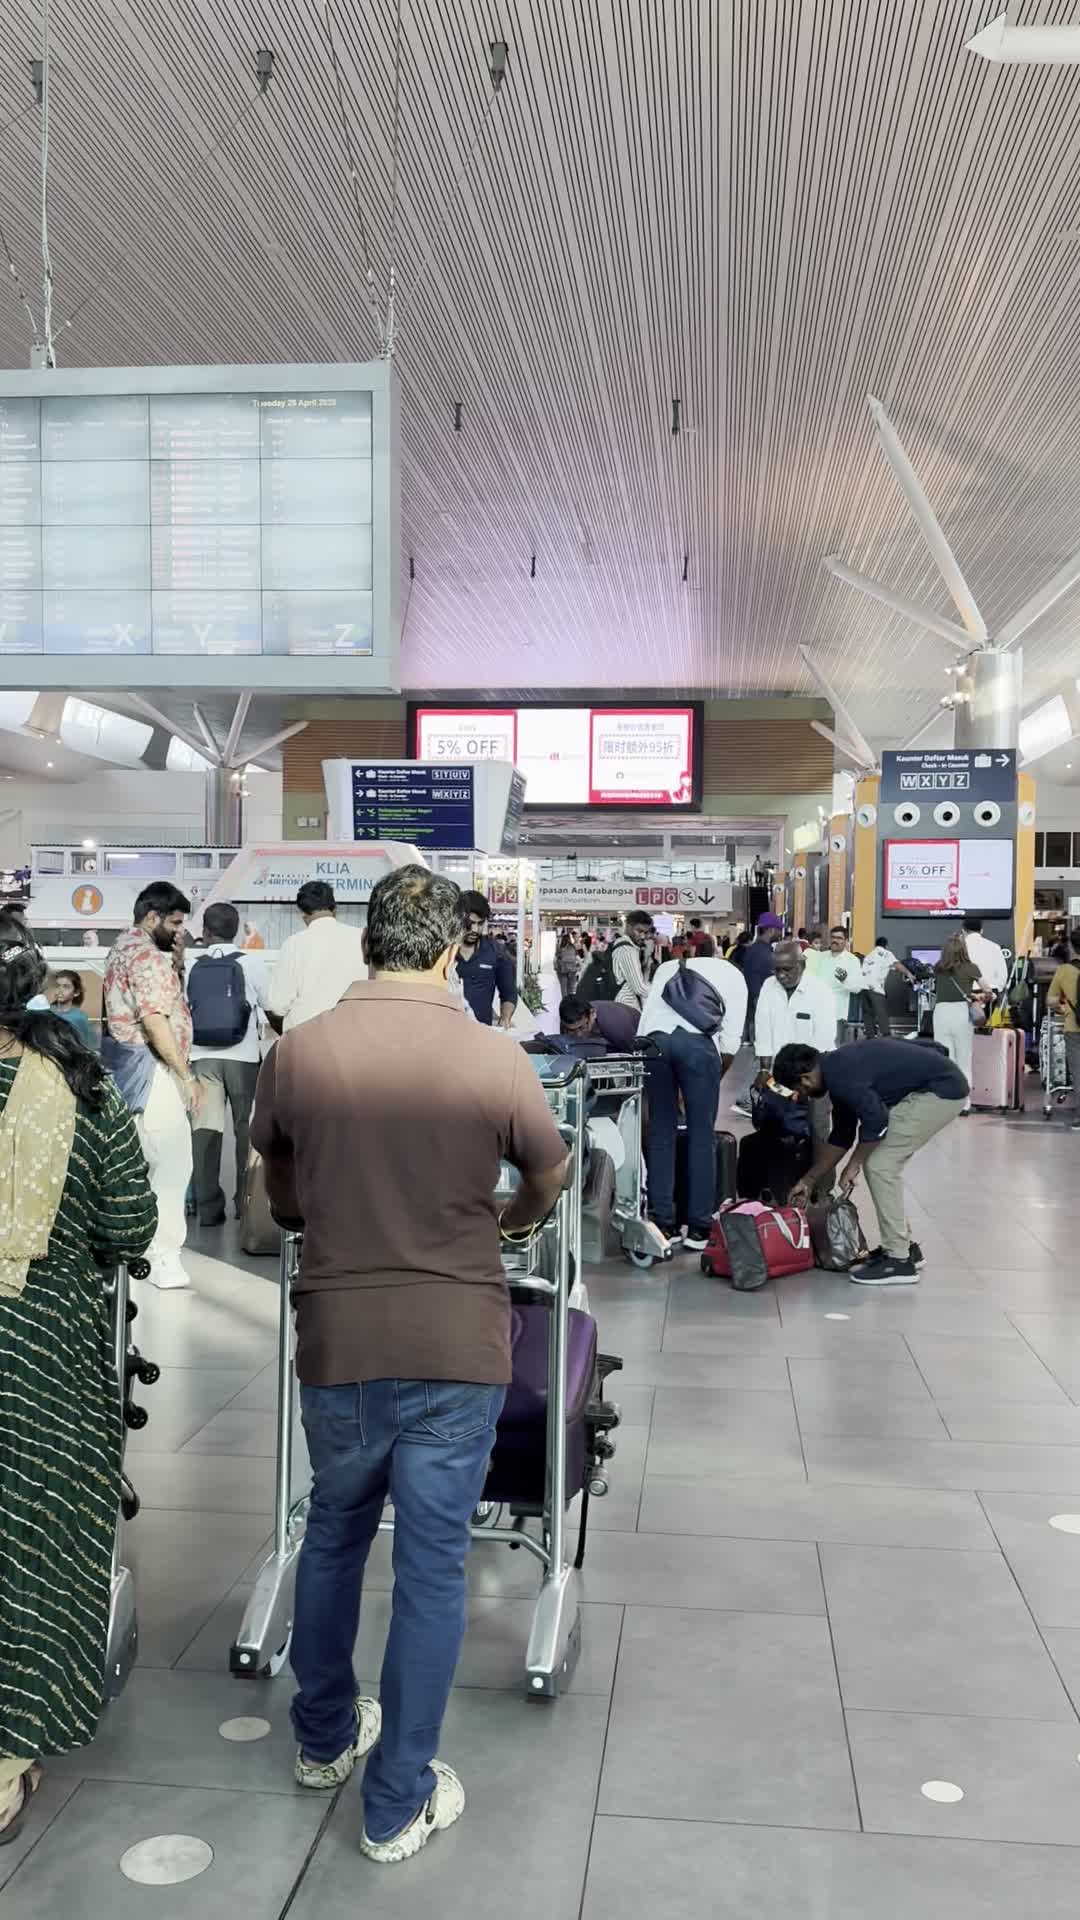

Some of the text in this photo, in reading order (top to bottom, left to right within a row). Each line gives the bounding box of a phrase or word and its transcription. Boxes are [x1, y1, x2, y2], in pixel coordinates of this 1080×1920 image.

[112, 624, 134, 647] X
[192, 624, 213, 647] Y
[334, 623, 355, 647] Z
[437, 740, 498, 755] 5% OFF
[316, 862, 350, 874] KLIA
[899, 866, 946, 875] 5% OFF
[316, 878, 374, 890] ERMIN
[571, 887, 634, 897] Antarabangsa
